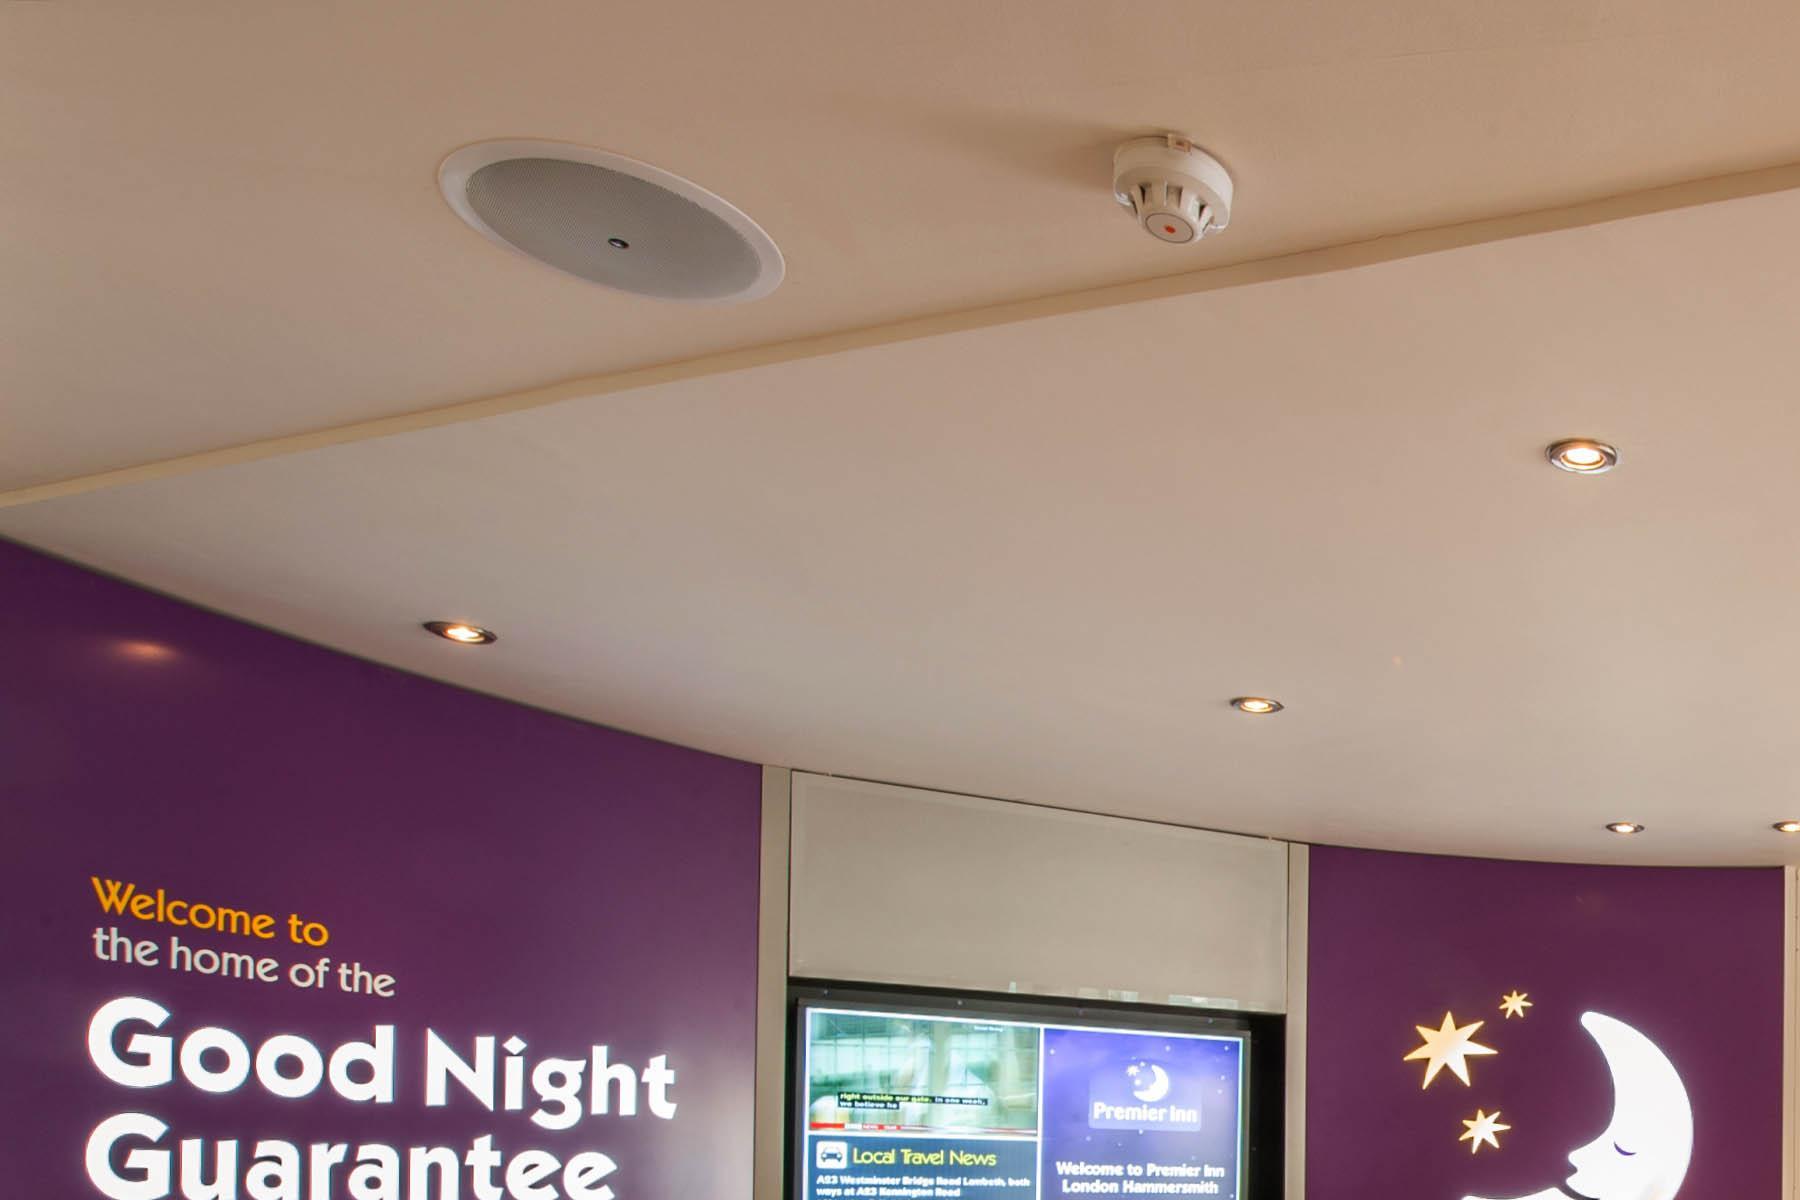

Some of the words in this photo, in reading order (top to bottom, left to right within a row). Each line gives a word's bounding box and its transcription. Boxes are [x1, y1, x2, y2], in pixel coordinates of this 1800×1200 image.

[91, 876, 276, 940] Welcome
[287, 912, 330, 947] to
[92, 927, 159, 967] the
[170, 937, 279, 983] home
[289, 957, 331, 989] of
[338, 962, 397, 998] the
[87, 996, 398, 1105] Good
[425, 1027, 678, 1131] Night
[1093, 1101, 1168, 1122] Premier
[1170, 1105, 1198, 1123] Inn
[853, 1148, 896, 1165] Local
[901, 1149, 944, 1166] Travel
[950, 1150, 998, 1167] News
[1056, 1161, 1124, 1176] Welcome
[1127, 1163, 1144, 1176] to
[1146, 1163, 1202, 1177] Premier
[1203, 1164, 1226, 1178] Inn
[816, 1175, 838, 1185] A23
[840, 1175, 900, 1186] Westminster
[902, 1176, 934, 1187] Bridge
[936, 1177, 962, 1187] Road
[963, 1177, 1007, 1188] Lambeth,
[1008, 1178, 1031, 1187] both
[1062, 1178, 1119, 1193] London
[1122, 1180, 1219, 1195] Hammersmith
[816, 1187, 842, 1198] ways
[843, 1188, 855, 1197] at
[856, 1187, 877, 1197] A23
[879, 1187, 934, 1198] Kennington
[935, 1188, 961, 1197] Road
